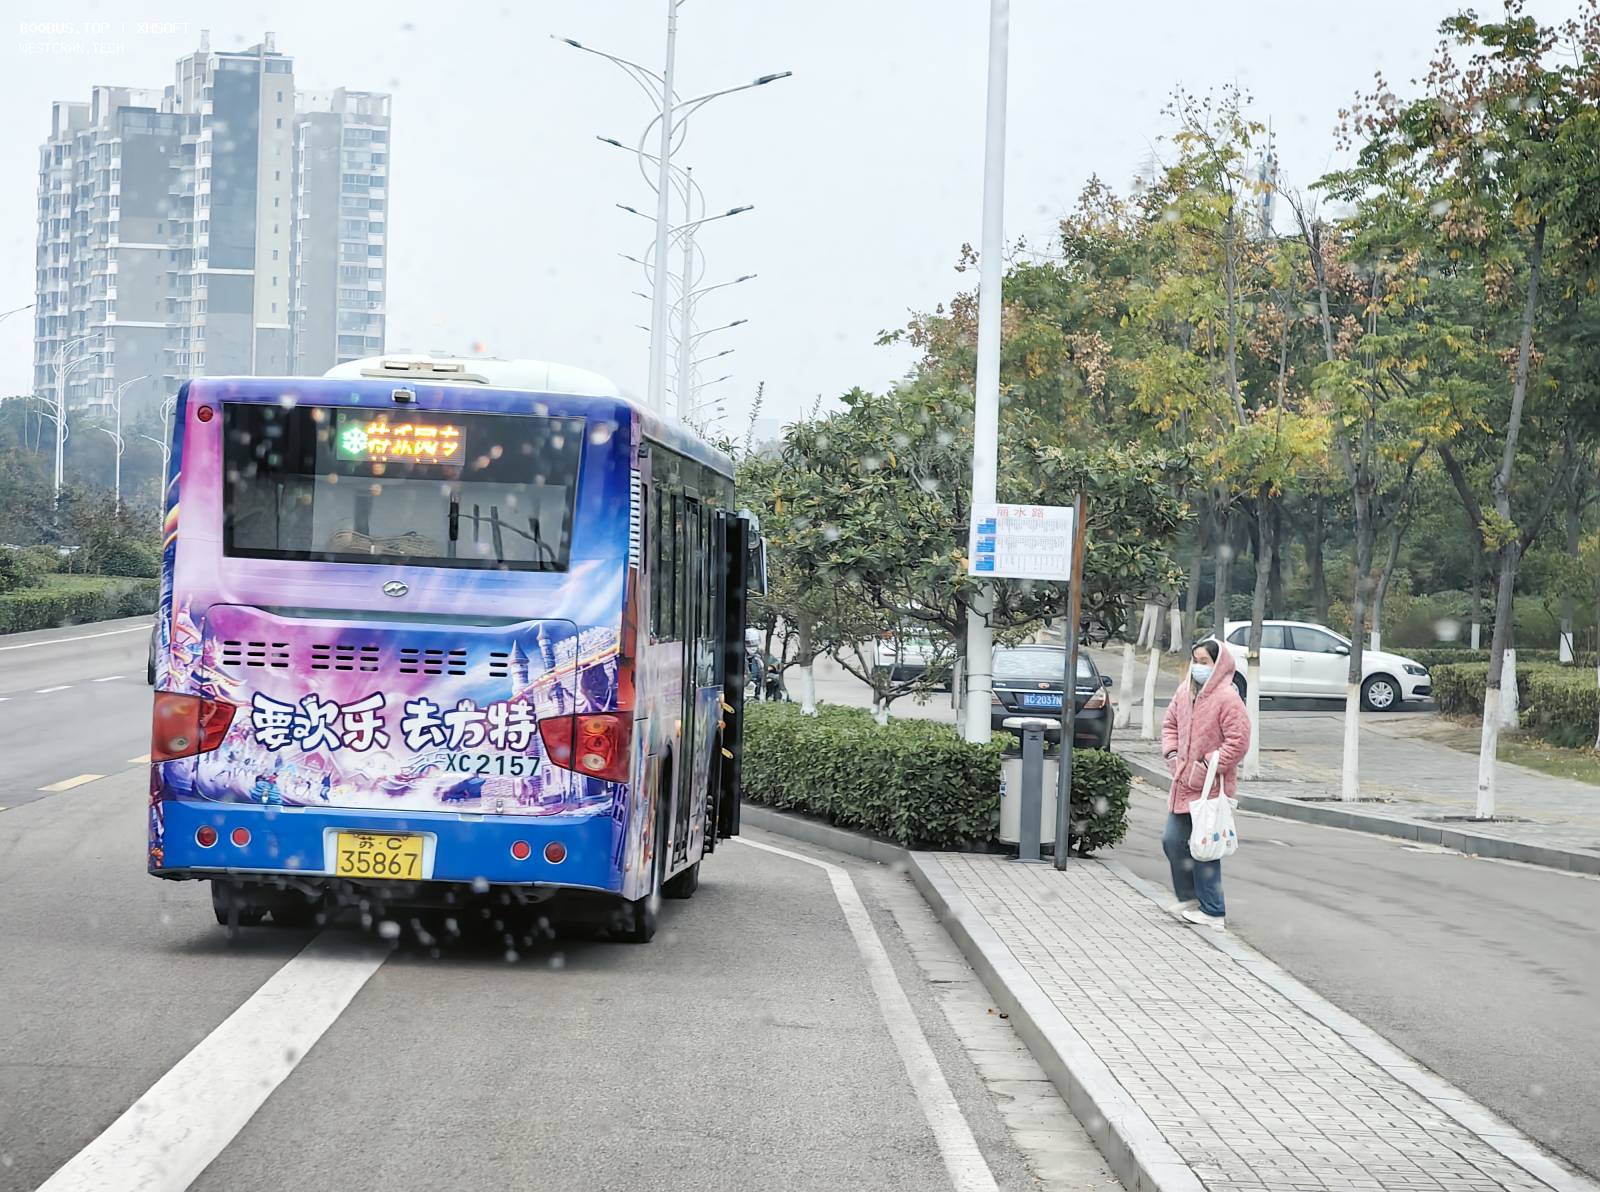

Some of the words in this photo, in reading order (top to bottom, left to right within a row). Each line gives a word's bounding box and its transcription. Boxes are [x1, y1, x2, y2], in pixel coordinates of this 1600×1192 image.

[997, 506, 1044, 518] 丽水路
[252, 691, 390, 752] 要欢乐
[401, 697, 537, 752] 去方特
[446, 753, 541, 777] XC2157
[341, 850, 418, 876] 35867
